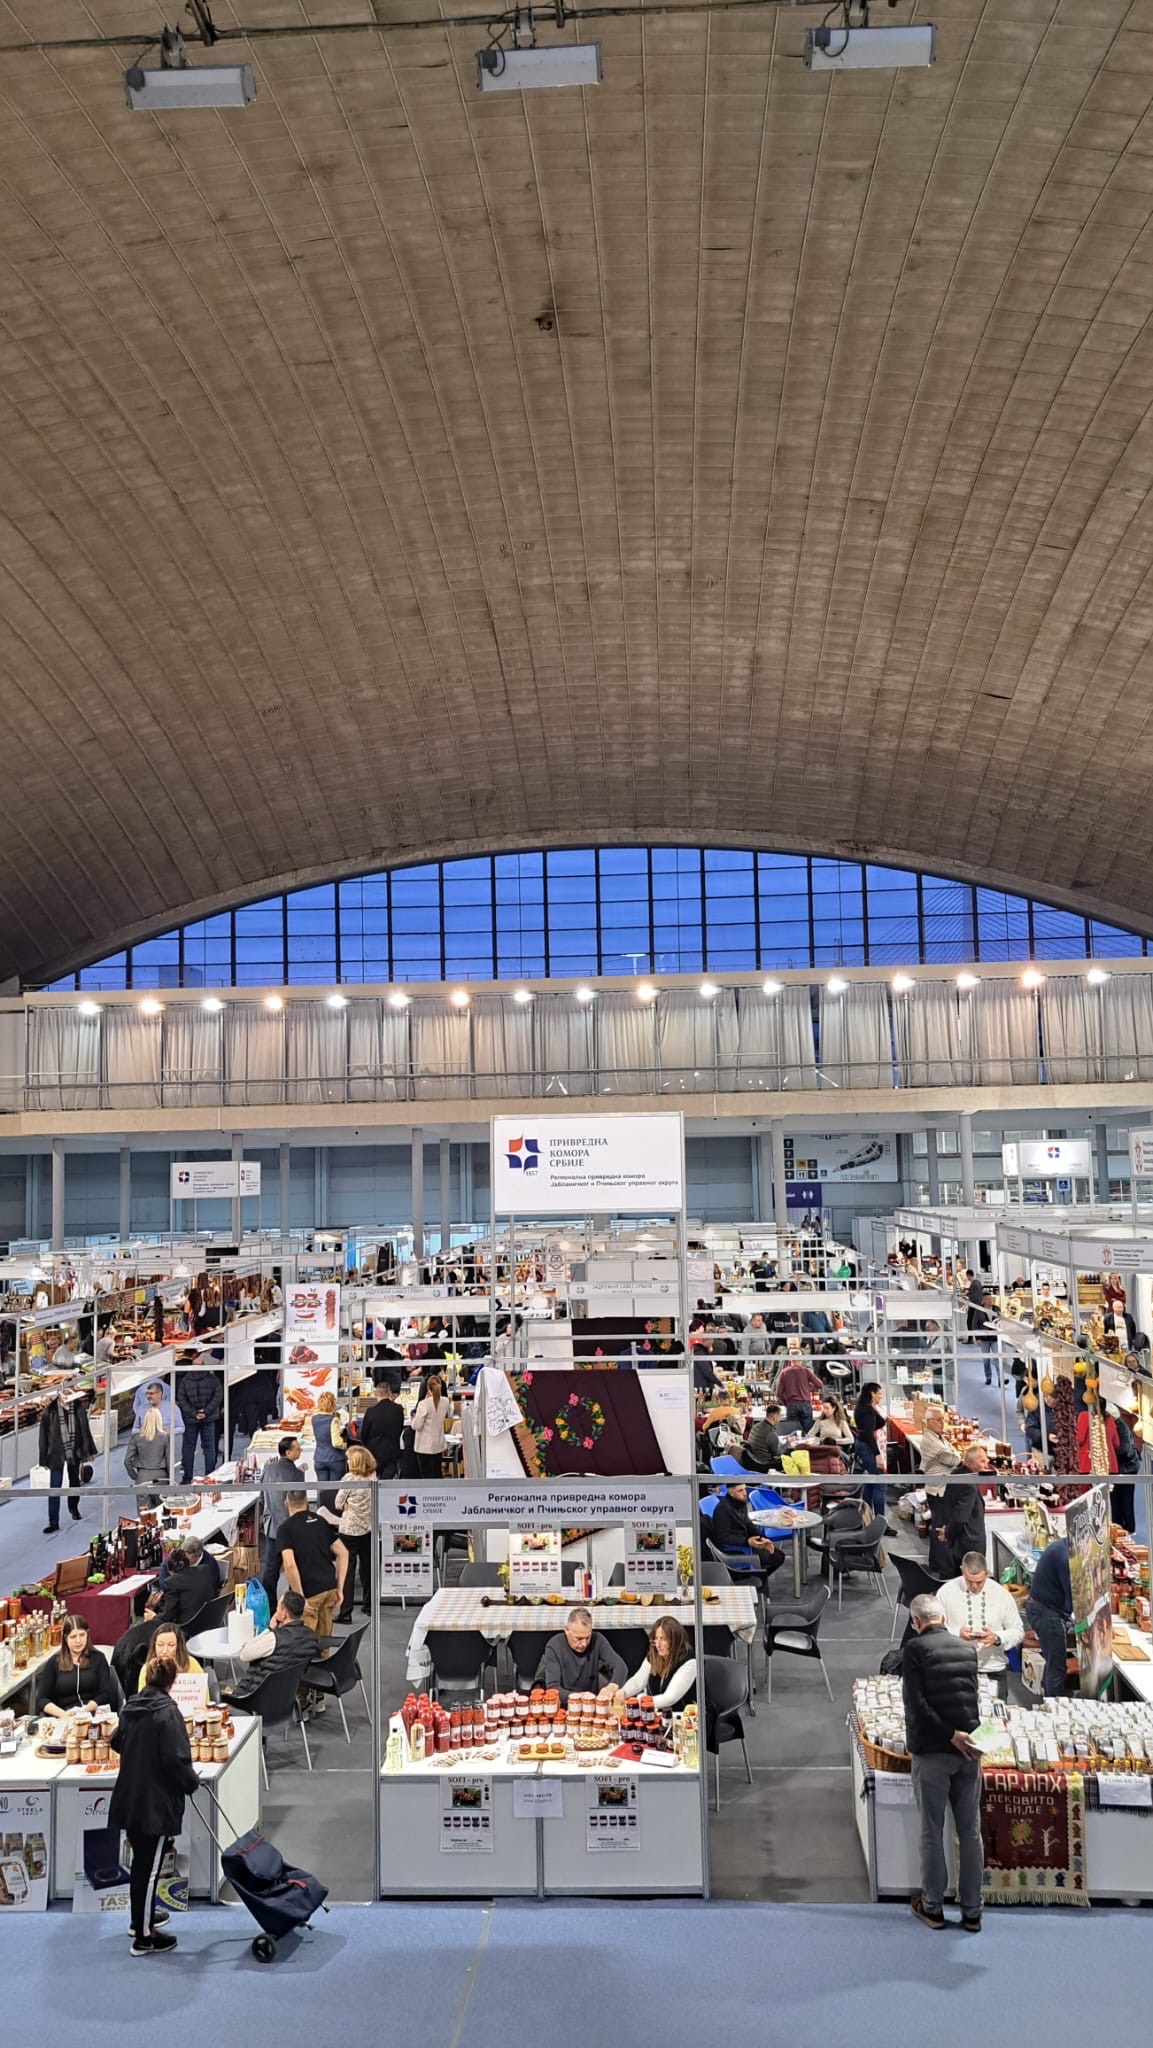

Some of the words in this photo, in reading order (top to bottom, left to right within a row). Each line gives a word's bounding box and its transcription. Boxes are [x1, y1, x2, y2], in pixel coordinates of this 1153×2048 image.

[549, 1138, 608, 1147] ПРИВРЕДНА
[549, 1149, 590, 1158] КОМОРА
[549, 1159, 585, 1167] СРБИЈЕ
[588, 1173, 621, 1181] привредна
[550, 1180, 589, 1188] Јабланичког
[658, 1179, 679, 1187] округа
[487, 1493, 548, 1503] Регионална
[550, 1493, 606, 1503] привредна
[608, 1492, 646, 1502] комора
[461, 1505, 525, 1515] Јабланичког
[537, 1504, 588, 1514] Пчињског
[590, 1505, 638, 1515] управног
[640, 1504, 674, 1515] округа
[447, 1776, 466, 1784] SOFI
[983, 1773, 1062, 1794] САРЛАХ
[986, 1794, 1055, 1806] ЛЕКОВИТО
[1005, 1804, 1042, 1815] БИЉЕ
